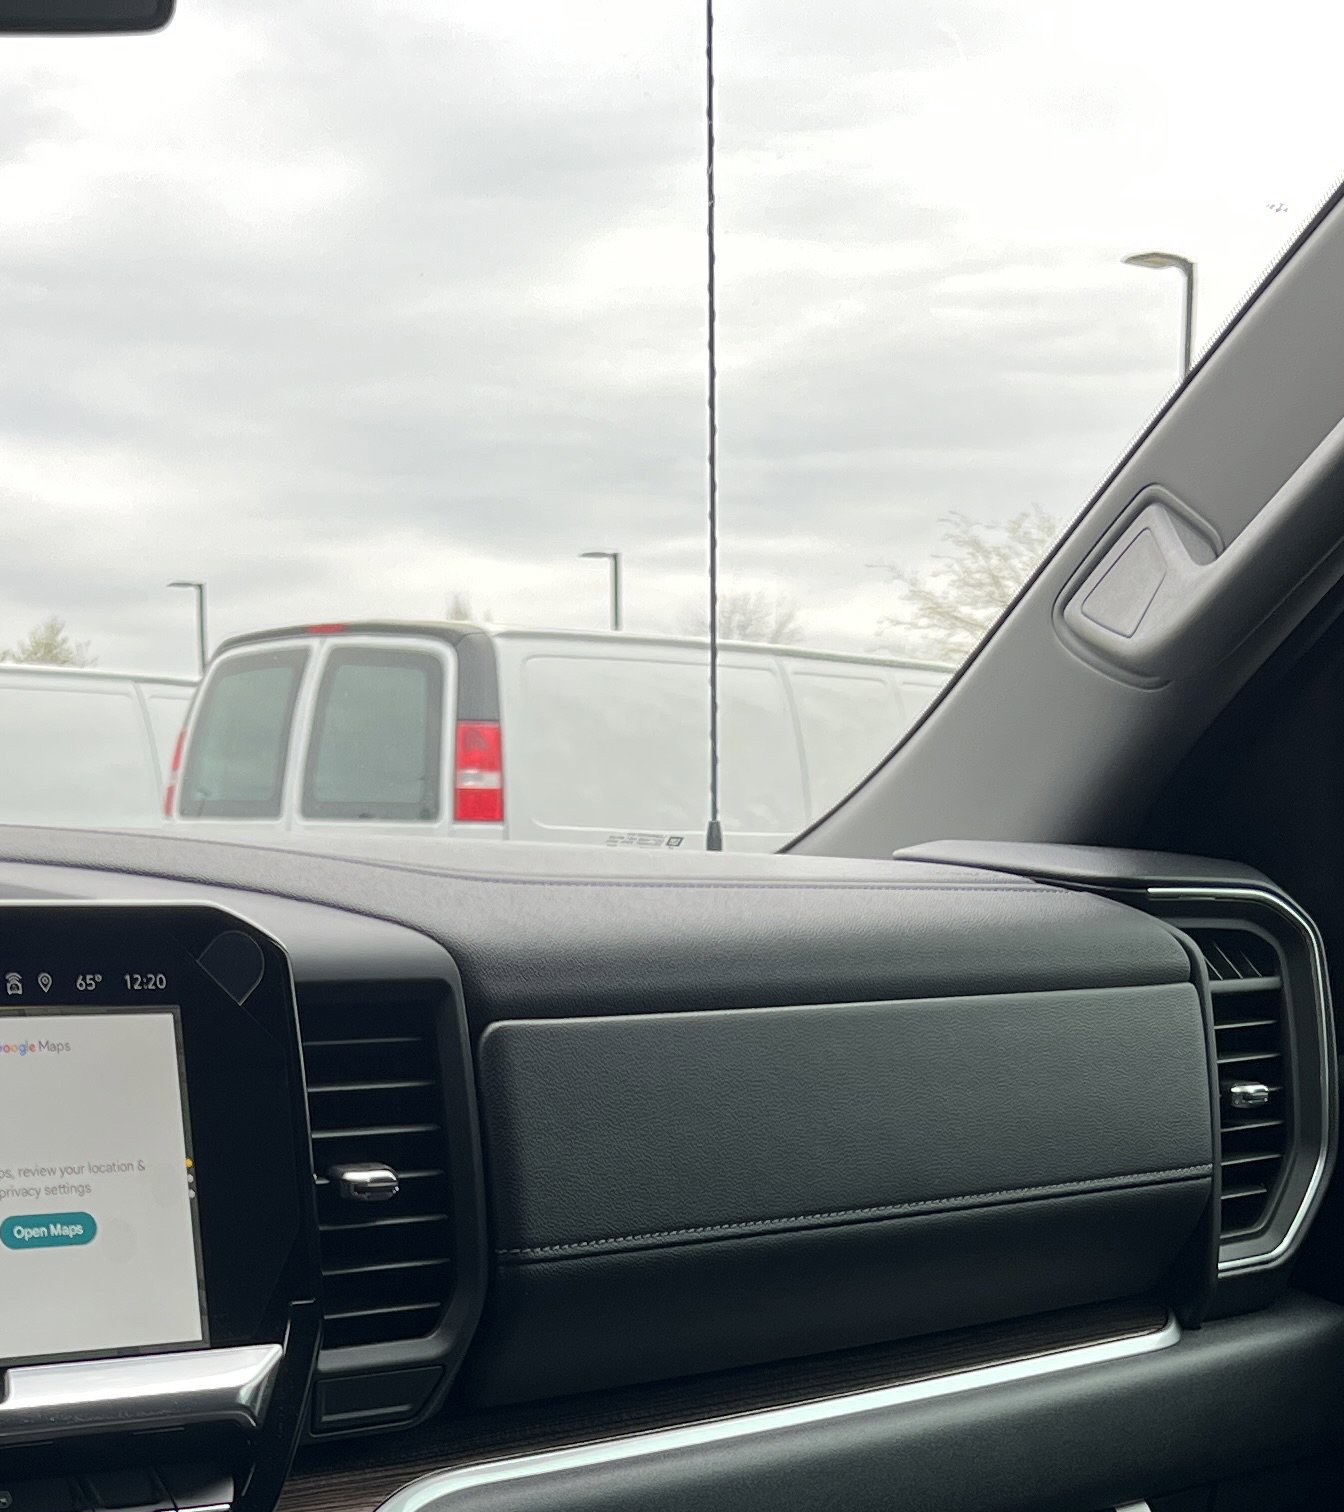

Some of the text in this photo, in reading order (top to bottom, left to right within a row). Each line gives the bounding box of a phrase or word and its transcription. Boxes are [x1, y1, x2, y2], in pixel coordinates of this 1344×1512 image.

[76, 973, 103, 991] 65°
[124, 973, 167, 991] 12:20
[38, 1039, 71, 1055] Maps
[18, 1165, 56, 1178] review
[58, 1165, 85, 1178] your
[88, 1161, 134, 1175] location
[137, 1159, 146, 1171] &
[44, 1182, 92, 1198] settings
[12, 1223, 84, 1241] Open Maps
